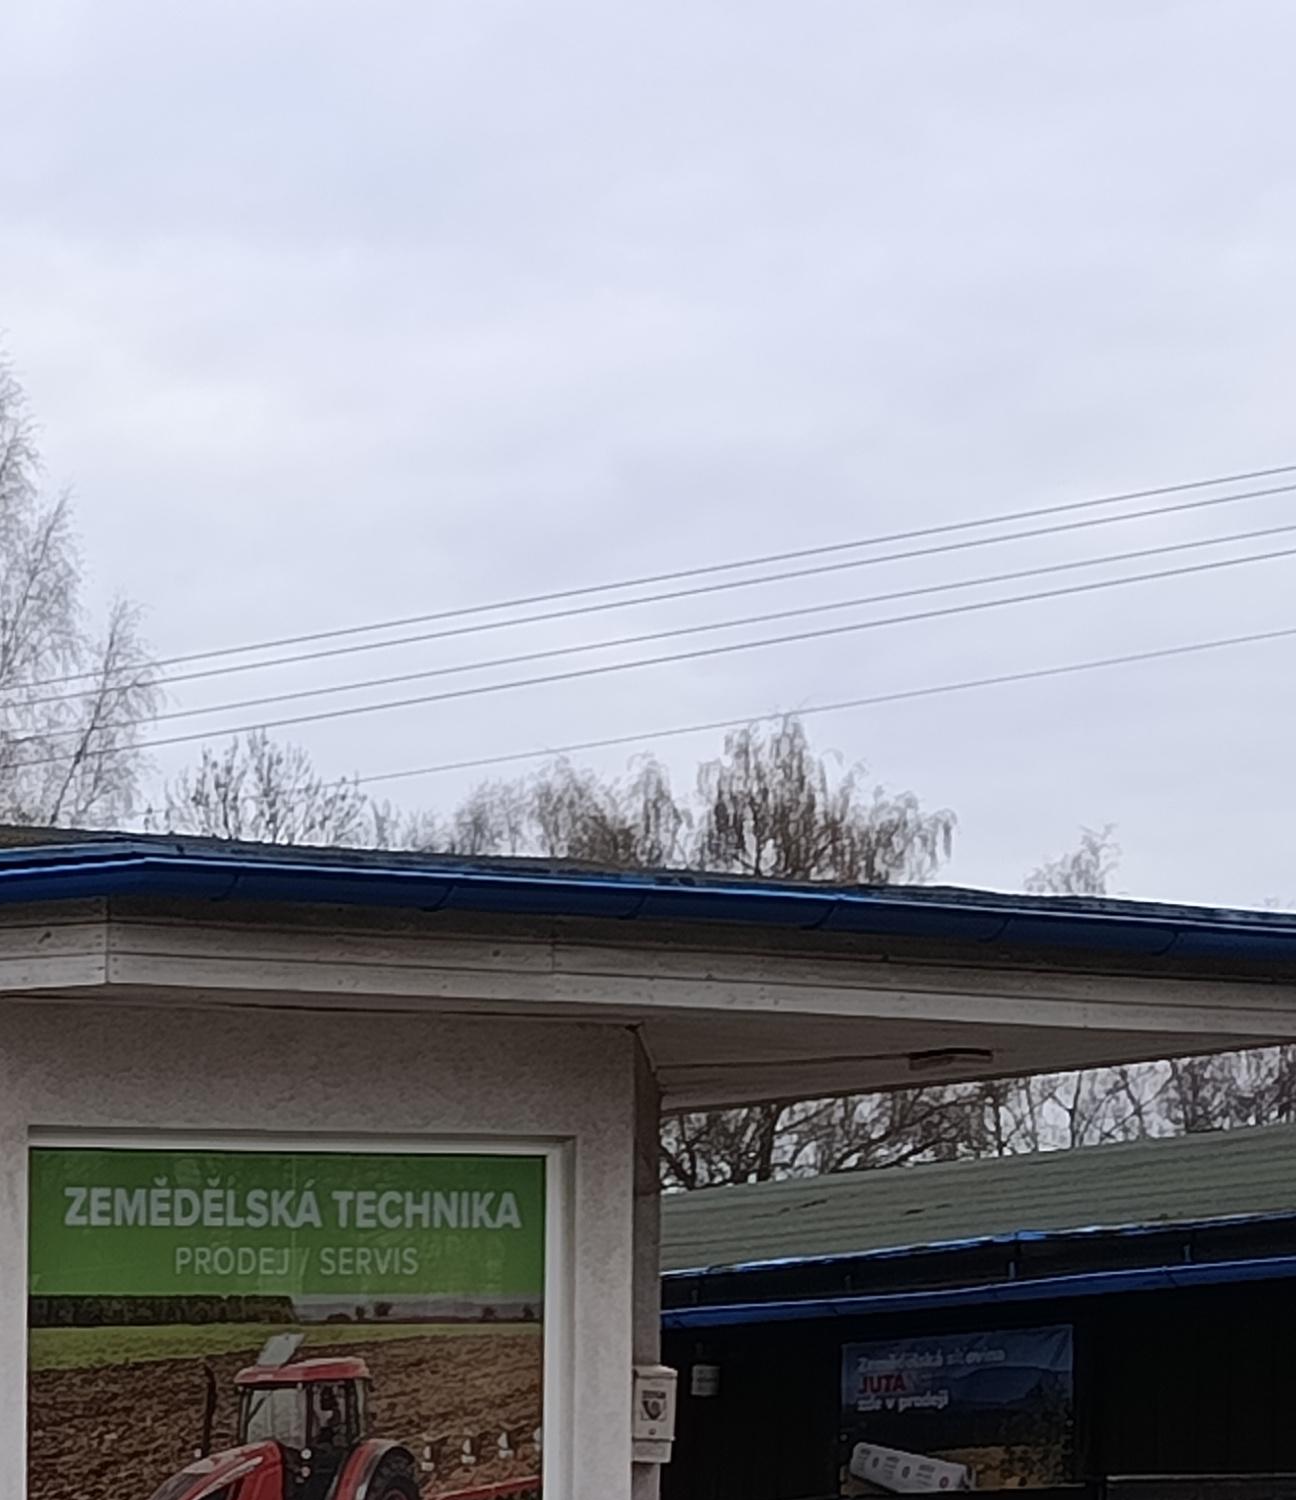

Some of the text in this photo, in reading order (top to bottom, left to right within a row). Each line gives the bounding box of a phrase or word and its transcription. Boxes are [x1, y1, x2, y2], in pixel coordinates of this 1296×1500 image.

[63, 1176, 523, 1229] ZEMĚDĚLSKÁ TECHNIKA
[175, 1247, 290, 1276] PRODEJ
[320, 1246, 419, 1276] SERVIS
[859, 1374, 907, 1394] JUTA
